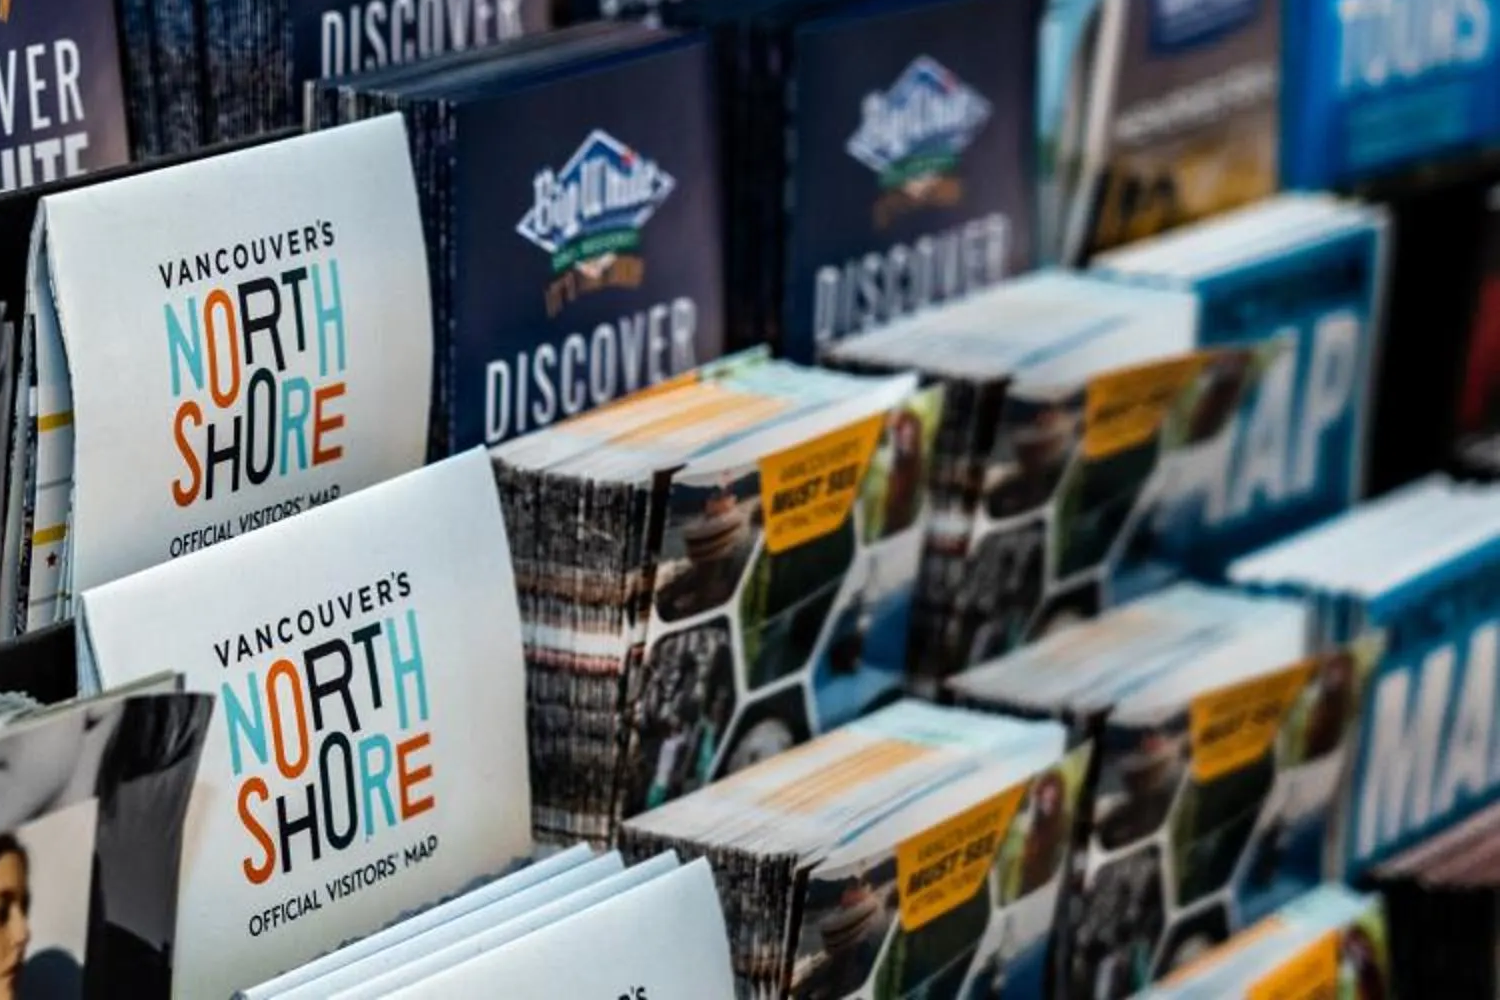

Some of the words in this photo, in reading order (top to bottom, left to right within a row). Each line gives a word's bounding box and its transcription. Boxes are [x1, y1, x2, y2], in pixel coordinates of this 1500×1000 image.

[158, 220, 336, 289] VANCOUVER'S
[163, 258, 347, 411] NORTH
[485, 297, 697, 444] DISCOVER
[172, 366, 347, 508] SHORE
[169, 520, 234, 558] OFFICIAL
[239, 495, 303, 536] VISITORS'
[214, 571, 411, 668] VANCOUVER'S
[221, 609, 430, 779] NORTH
[1354, 616, 1500, 860] MA
[236, 731, 436, 886] SHORE
[248, 889, 323, 937] OFFICIAL
[325, 852, 400, 902] VISITORS'
[402, 834, 439, 868] MAP
